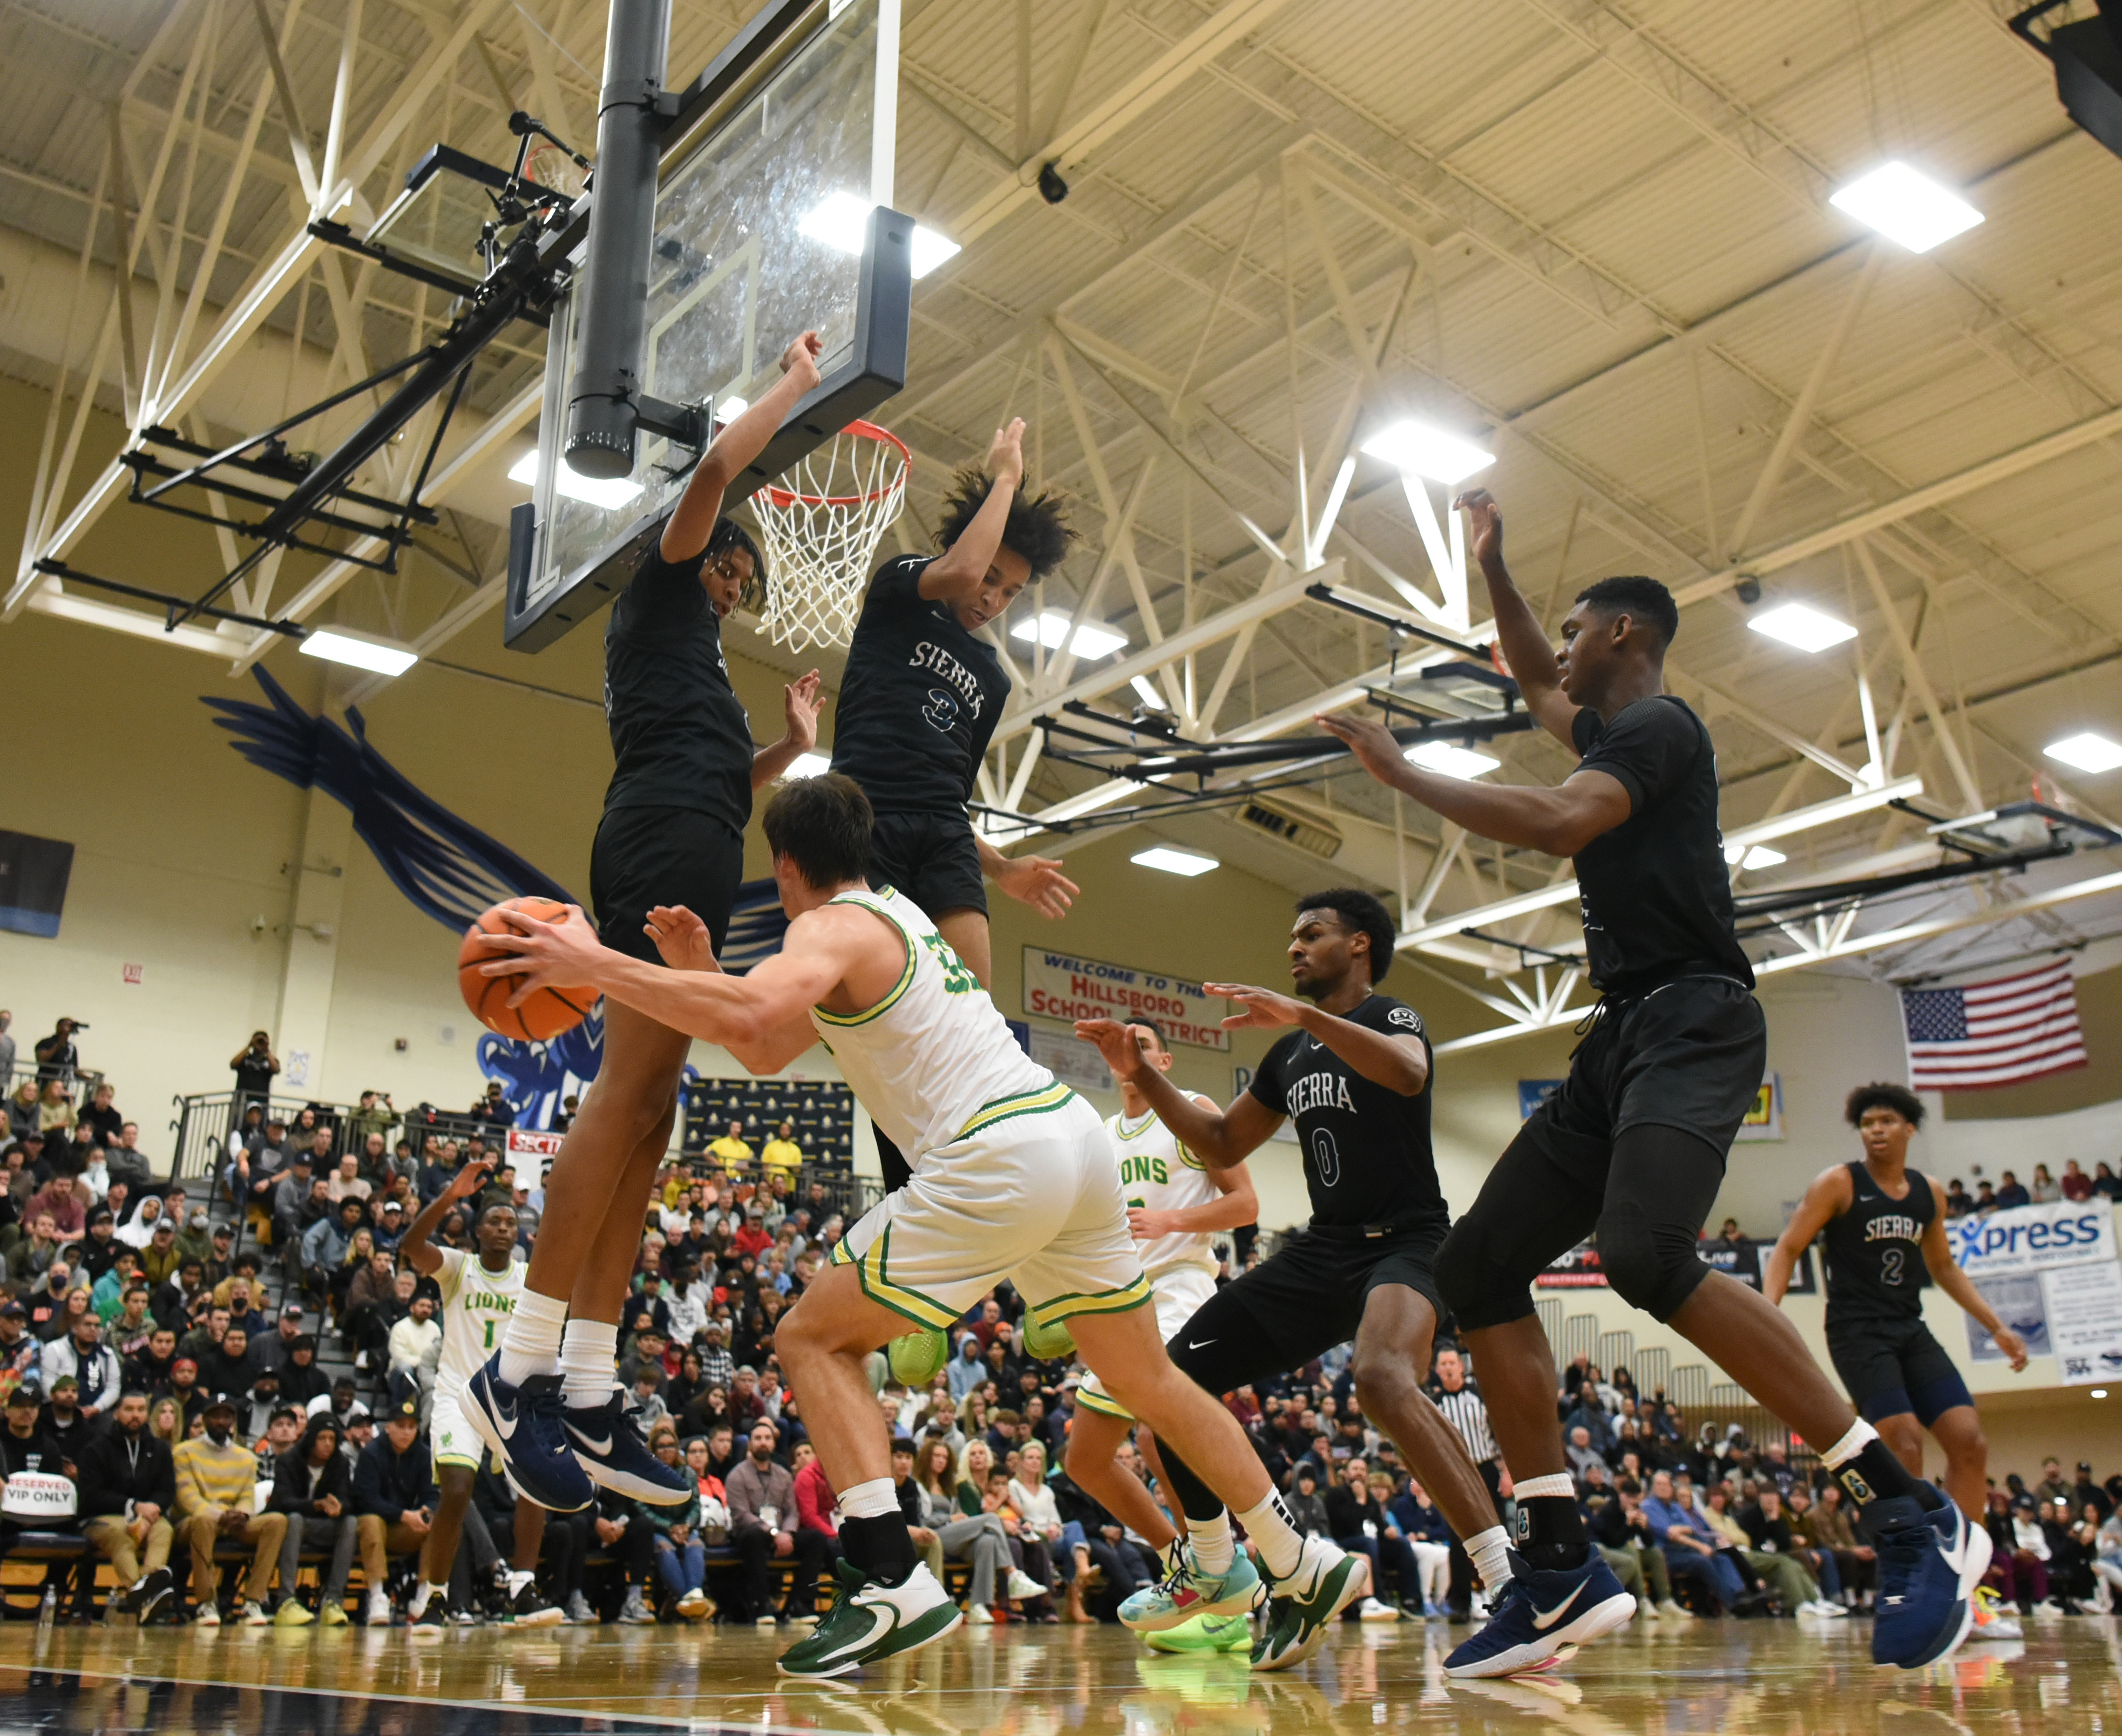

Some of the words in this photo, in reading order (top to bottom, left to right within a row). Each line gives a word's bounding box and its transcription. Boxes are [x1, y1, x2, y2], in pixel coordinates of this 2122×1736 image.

[909, 641, 984, 720] SIERRA
[922, 688, 958, 732] 3
[1045, 954, 1136, 984] WELCOME
[1145, 976, 1167, 990] TO
[1177, 982, 1206, 999] THE
[1071, 975, 1185, 1018] HILLSBORO
[1287, 1073, 1357, 1124] SIERRA
[1118, 1156, 1168, 1185] ONS
[1312, 1128, 1339, 1186] 0
[1881, 1248, 1904, 1286] 2
[484, 1319, 496, 1348] 1
[8, 1489, 29, 1500] VIP
[33, 1491, 70, 1502] ONLY
[9, 1479, 70, 1490] RESERVED
